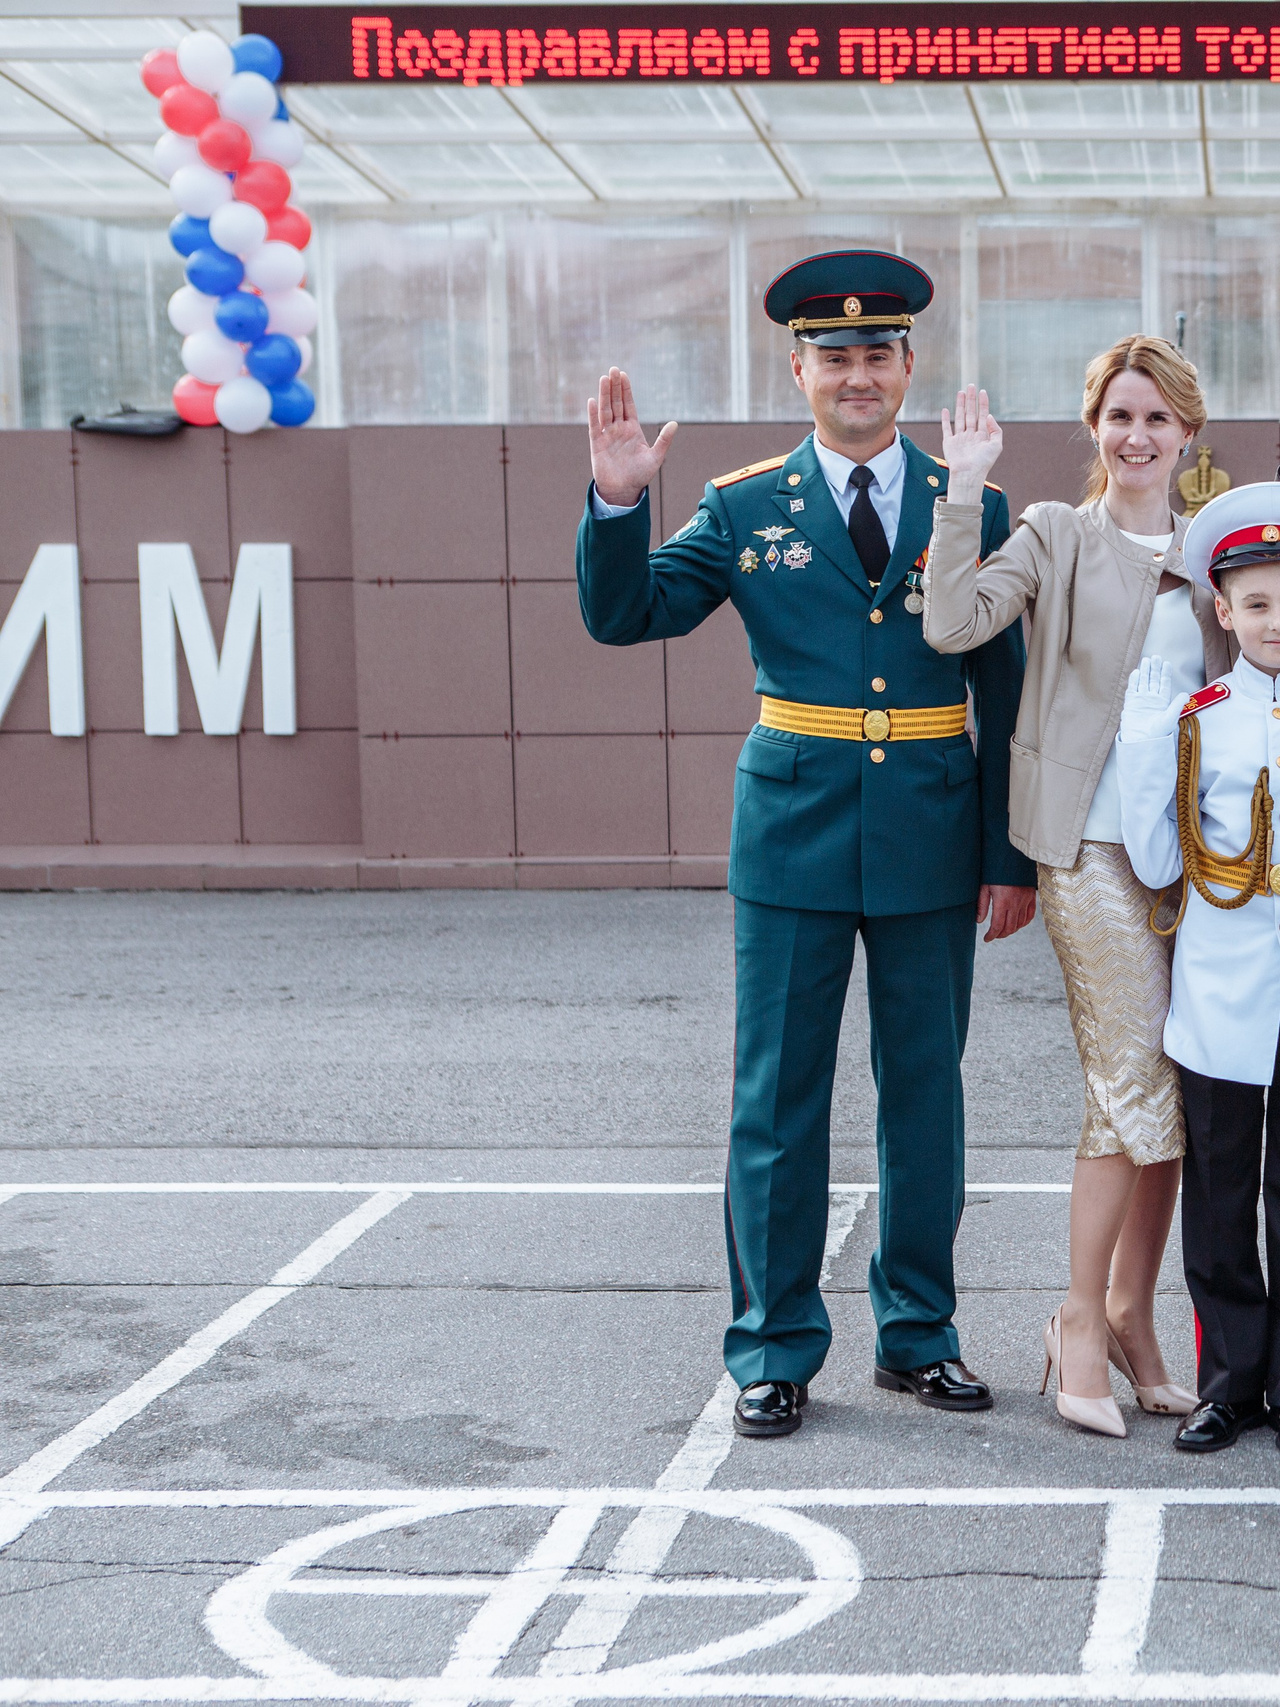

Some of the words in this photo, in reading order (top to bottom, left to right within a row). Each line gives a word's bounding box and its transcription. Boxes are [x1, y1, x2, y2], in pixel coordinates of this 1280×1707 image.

[351, 16, 770, 87] Поздравляем
[787, 28, 819, 75] с
[838, 26, 1182, 84] принятием
